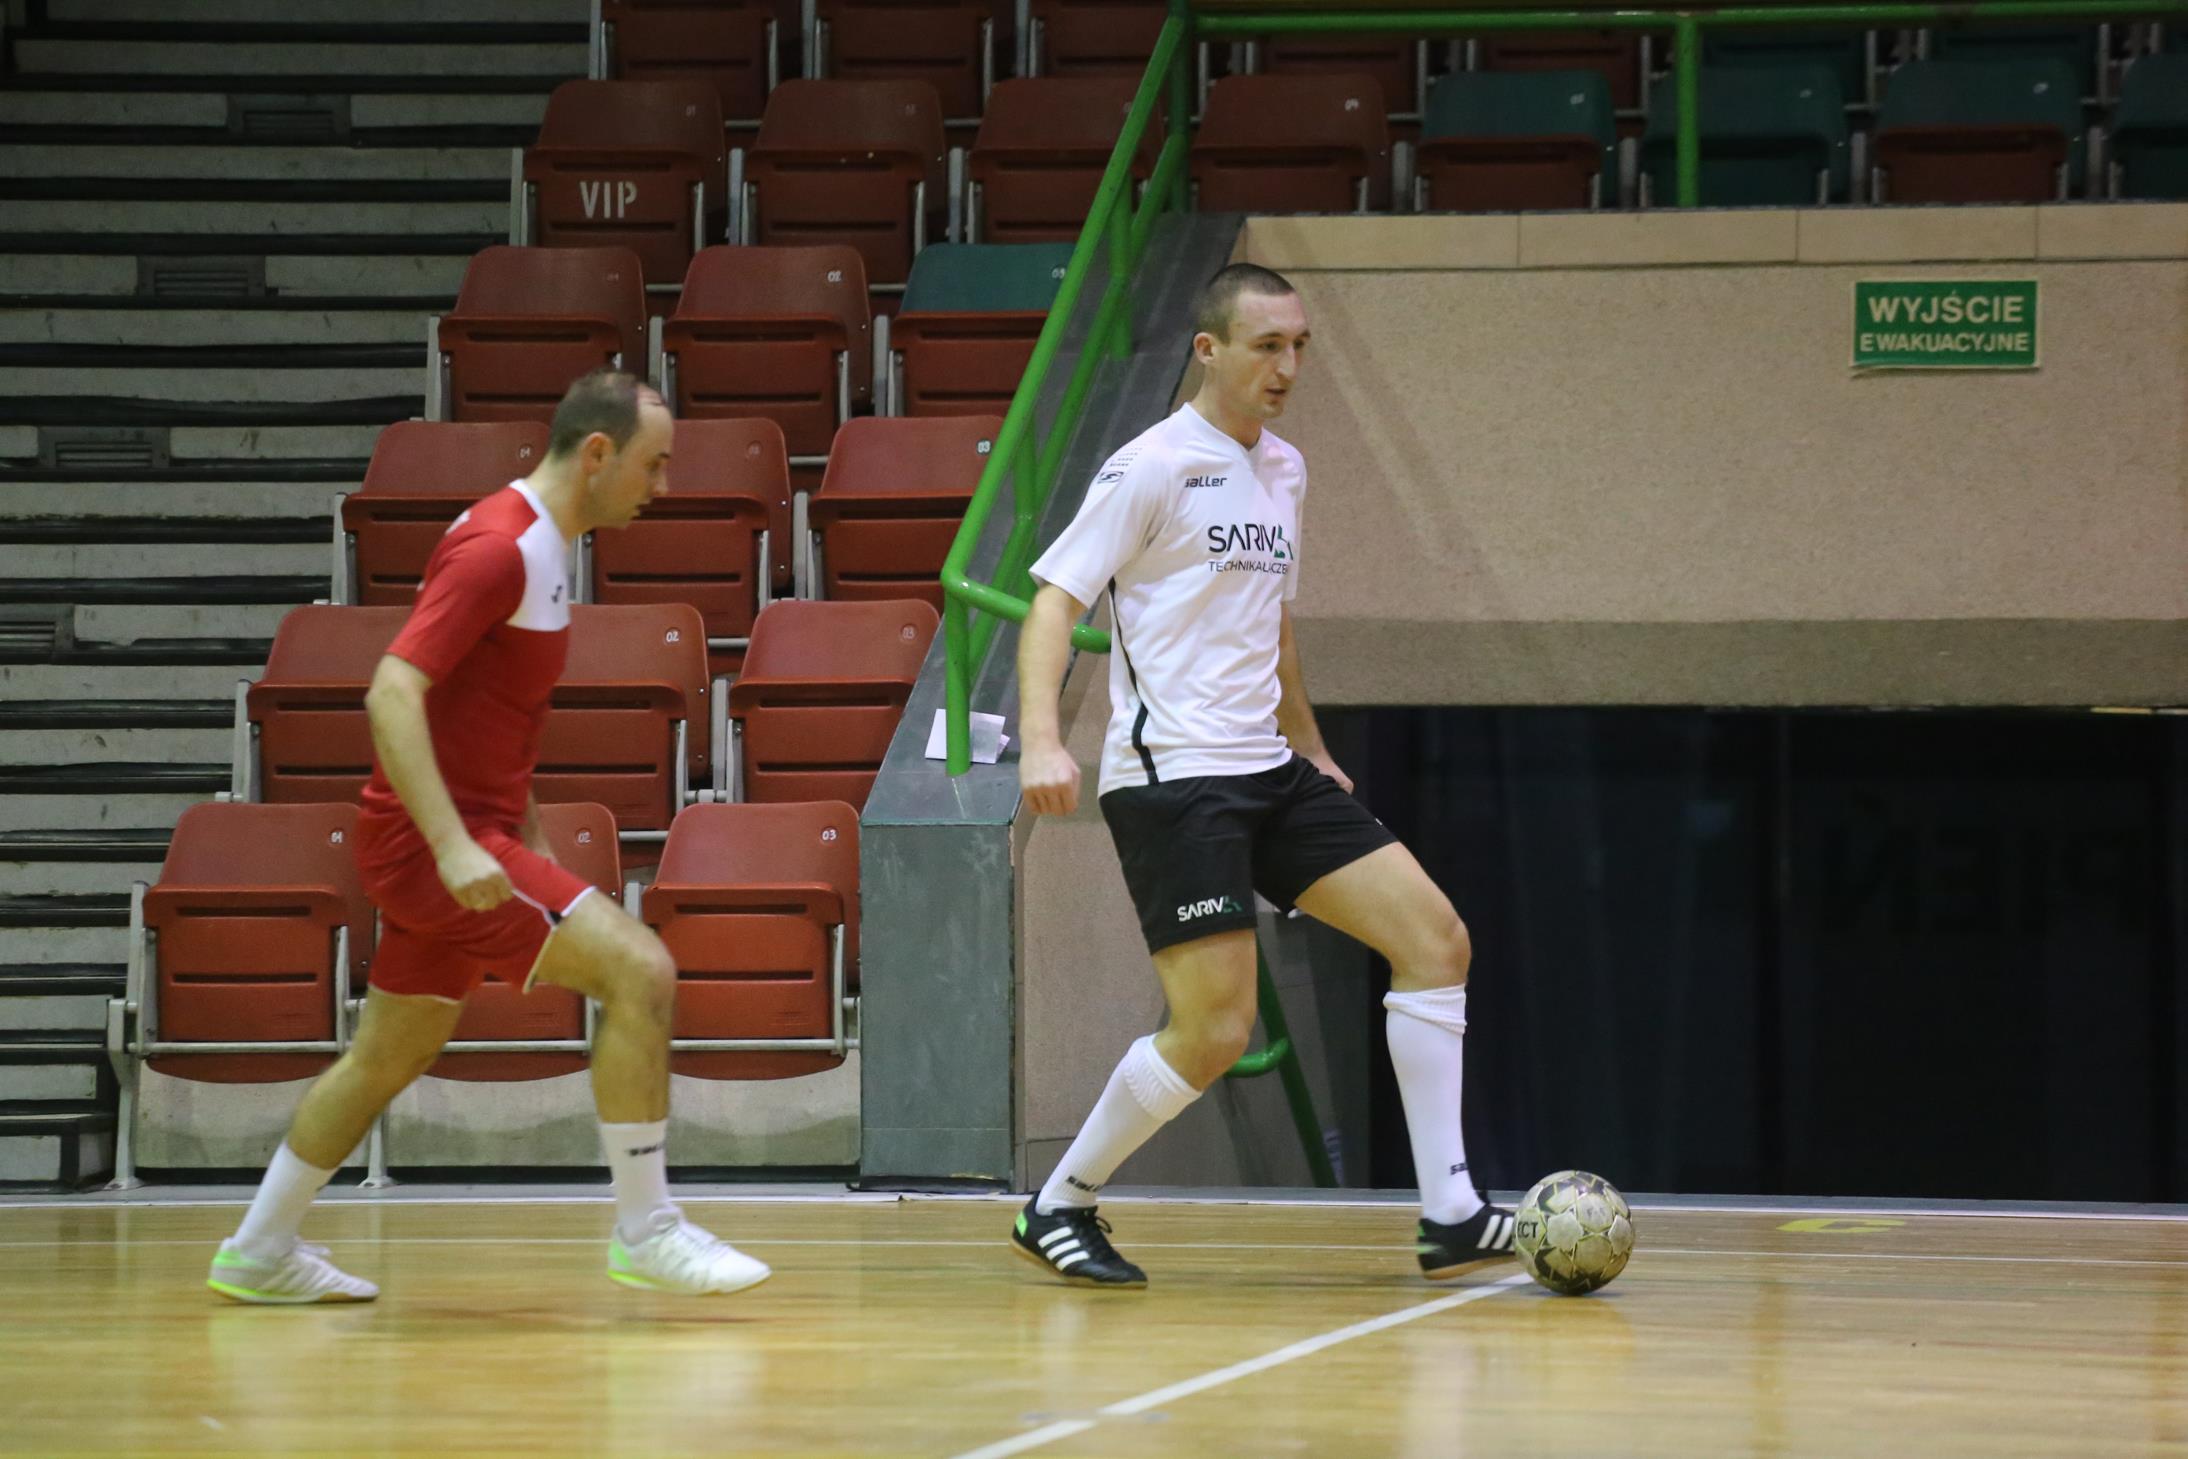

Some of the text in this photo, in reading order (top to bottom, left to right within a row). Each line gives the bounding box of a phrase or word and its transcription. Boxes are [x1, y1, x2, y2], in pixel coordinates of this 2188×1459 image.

[579, 181, 638, 219] VIP
[1868, 290, 2025, 324] WYJŚCIE
[1860, 332, 2029, 352] EWAKUACYJNE
[665, 630, 681, 643] 02
[577, 830, 593, 844] 02
[821, 828, 838, 843] 03
